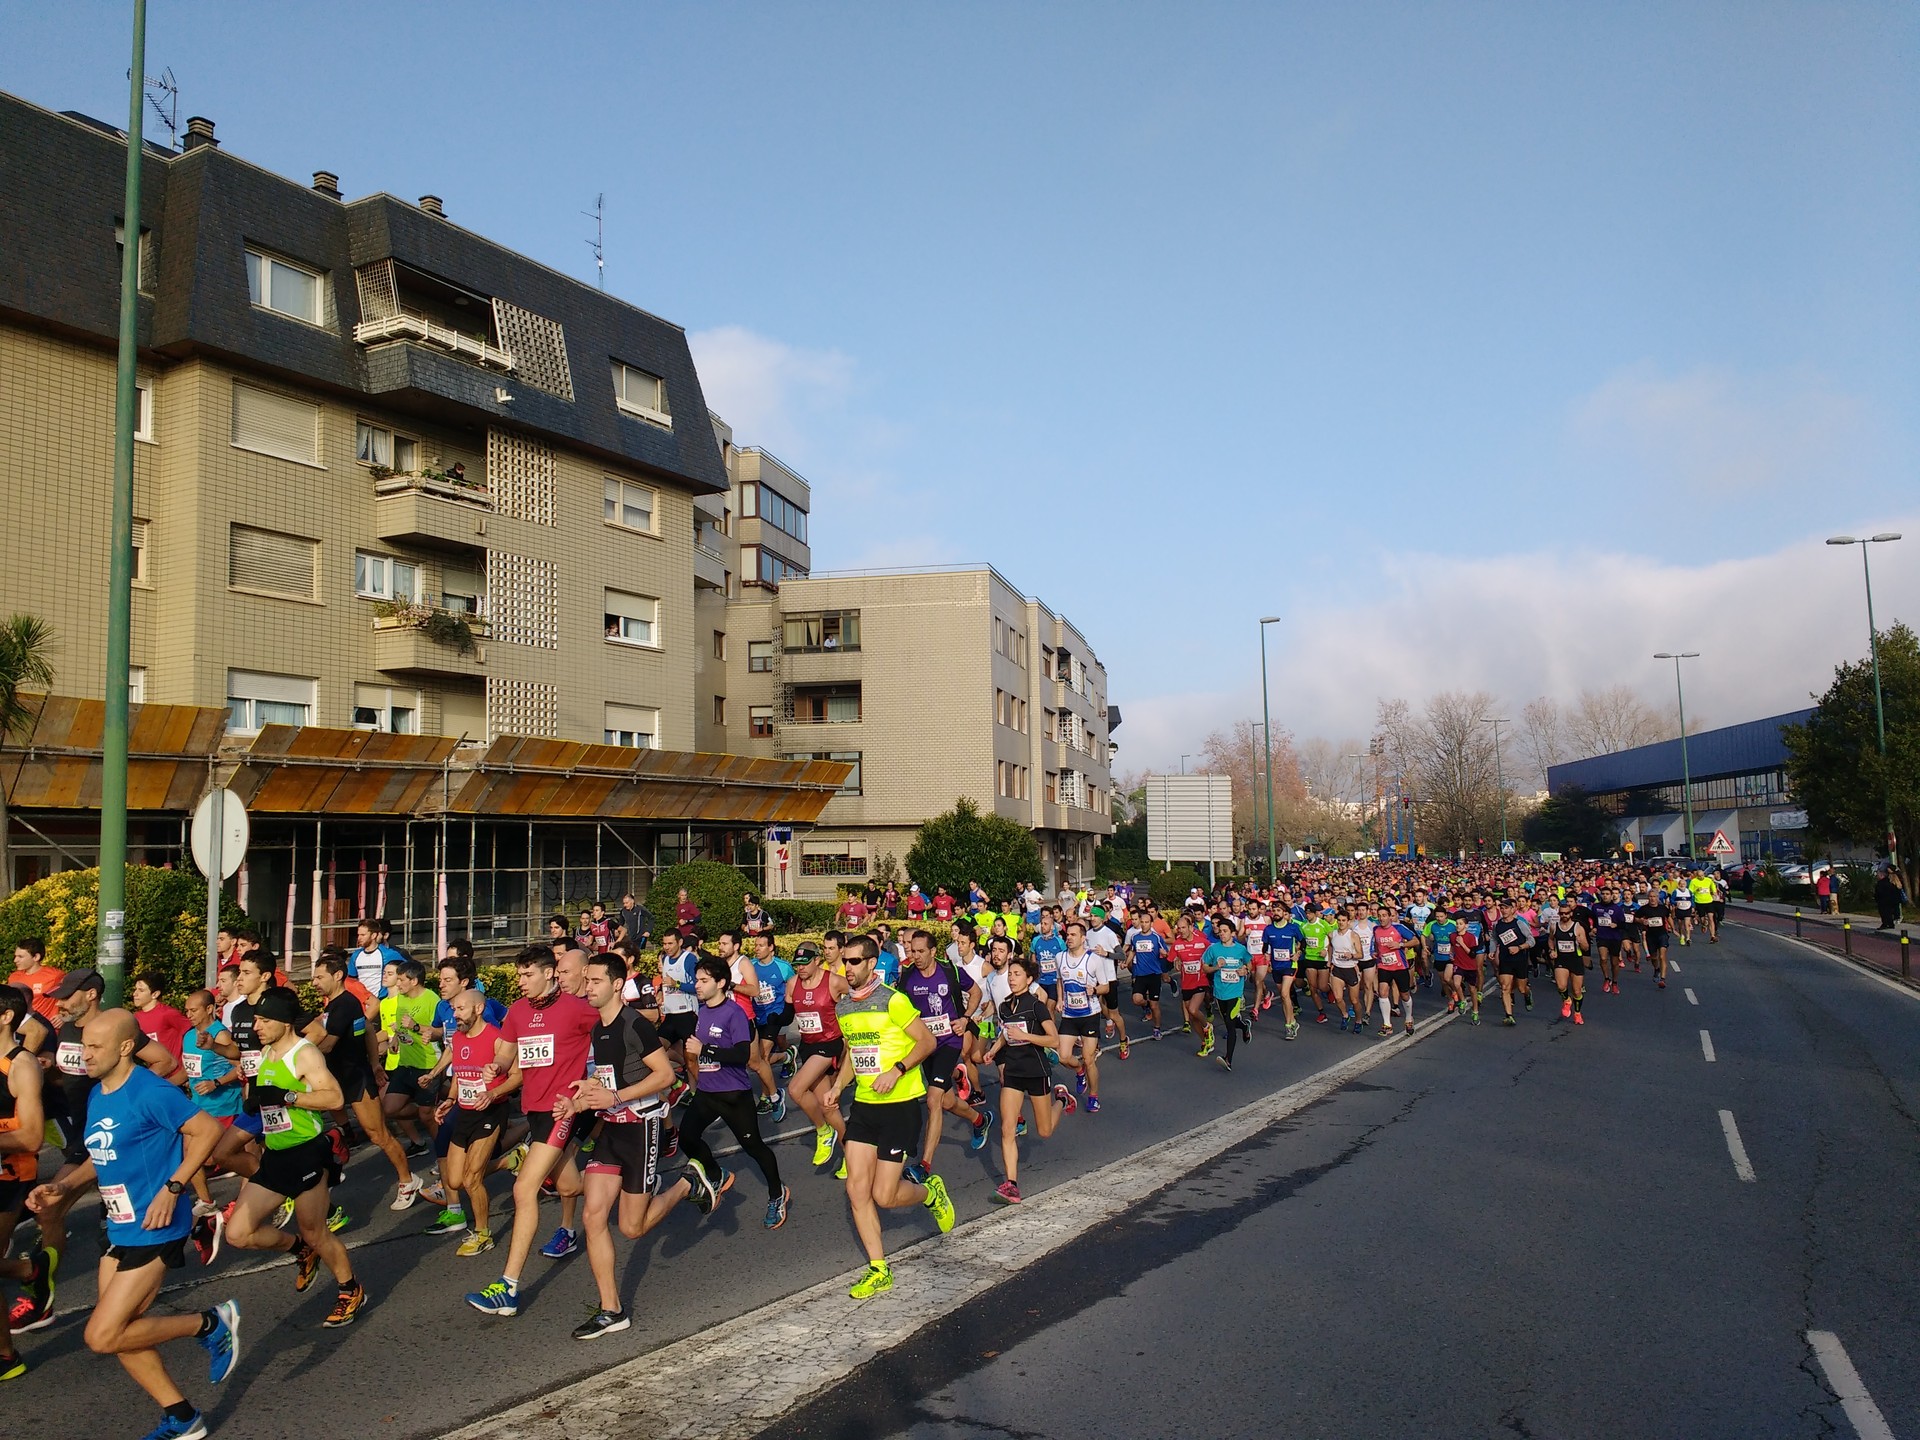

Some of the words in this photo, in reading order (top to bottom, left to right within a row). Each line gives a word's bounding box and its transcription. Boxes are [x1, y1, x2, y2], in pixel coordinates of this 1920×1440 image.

[1070, 997, 1084, 1005] 806
[528, 1021, 545, 1029] Getxo
[800, 1019, 815, 1028] 373
[521, 1045, 549, 1060] 3516
[62, 1053, 82, 1068] 444
[853, 1055, 877, 1068] 3968
[263, 1111, 285, 1126] 1861
[647, 1145, 657, 1185] Getxo
